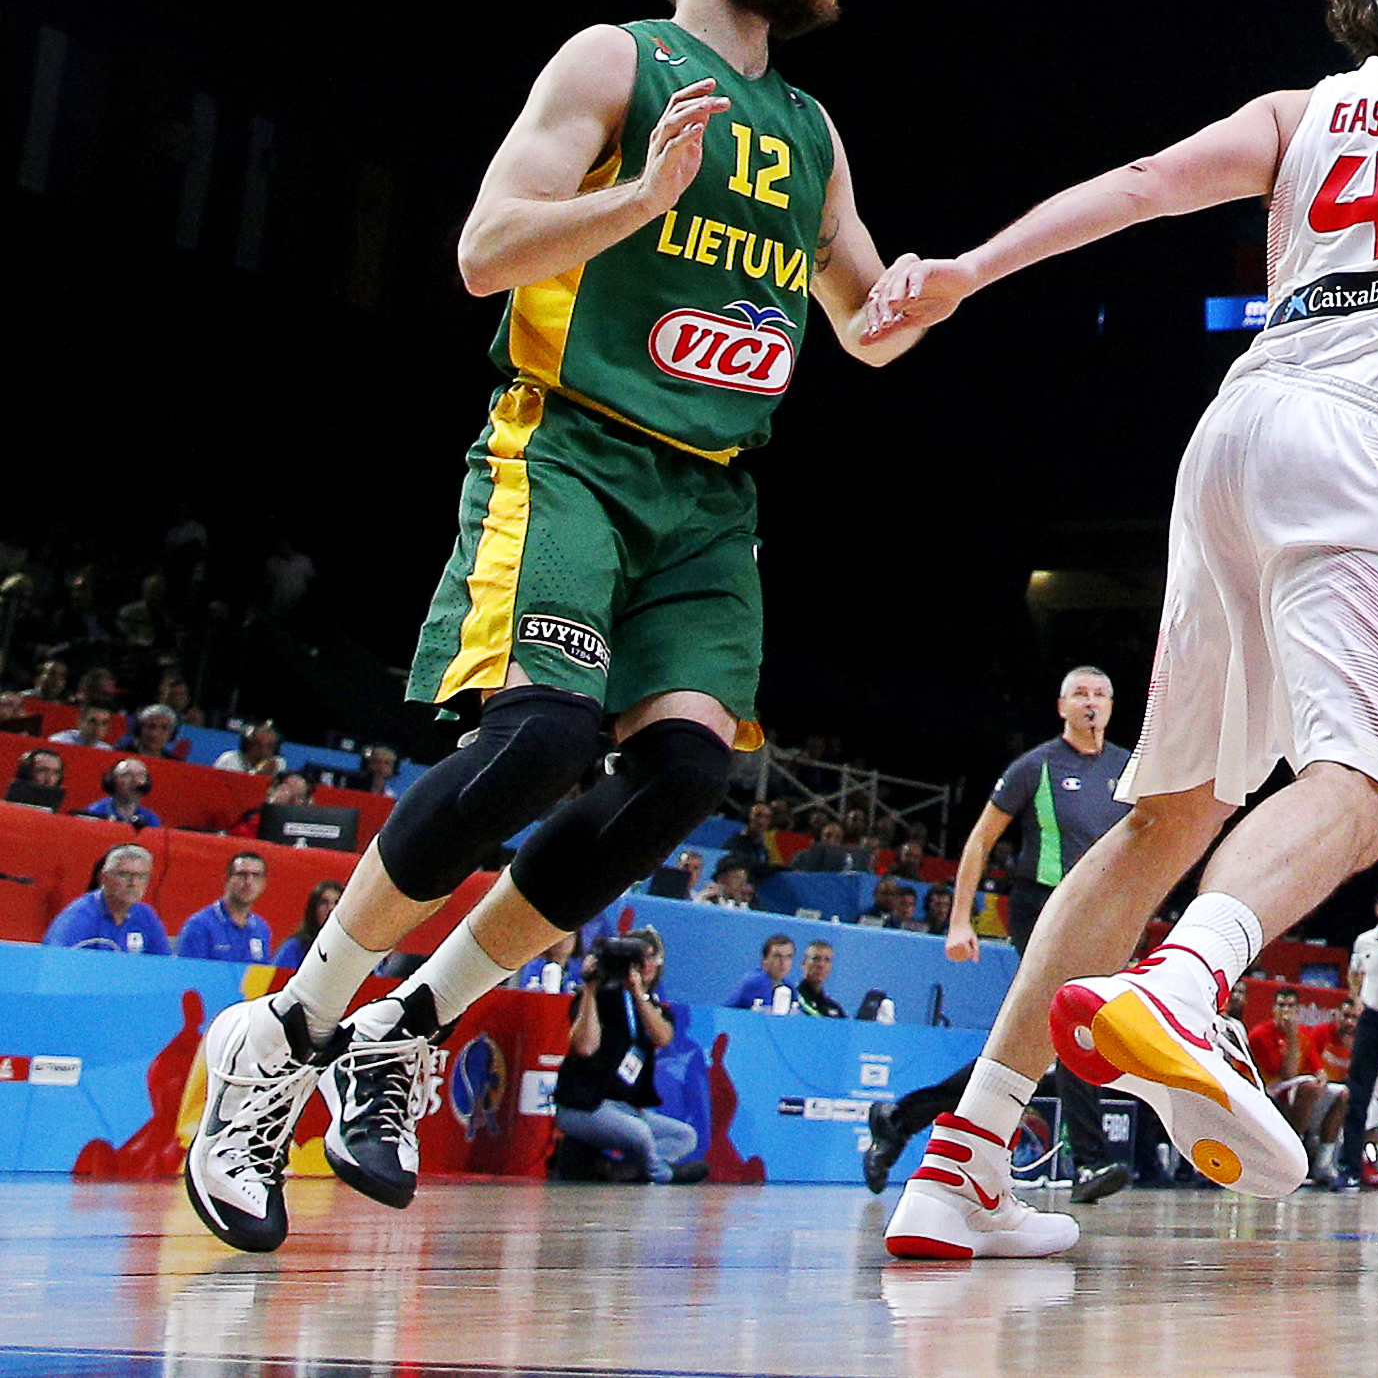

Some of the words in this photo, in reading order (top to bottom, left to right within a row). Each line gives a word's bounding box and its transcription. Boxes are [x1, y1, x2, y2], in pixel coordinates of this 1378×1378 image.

[728, 122, 790, 209] 12
[657, 210, 809, 298] LIETUVA
[672, 324, 785, 380] VICI
